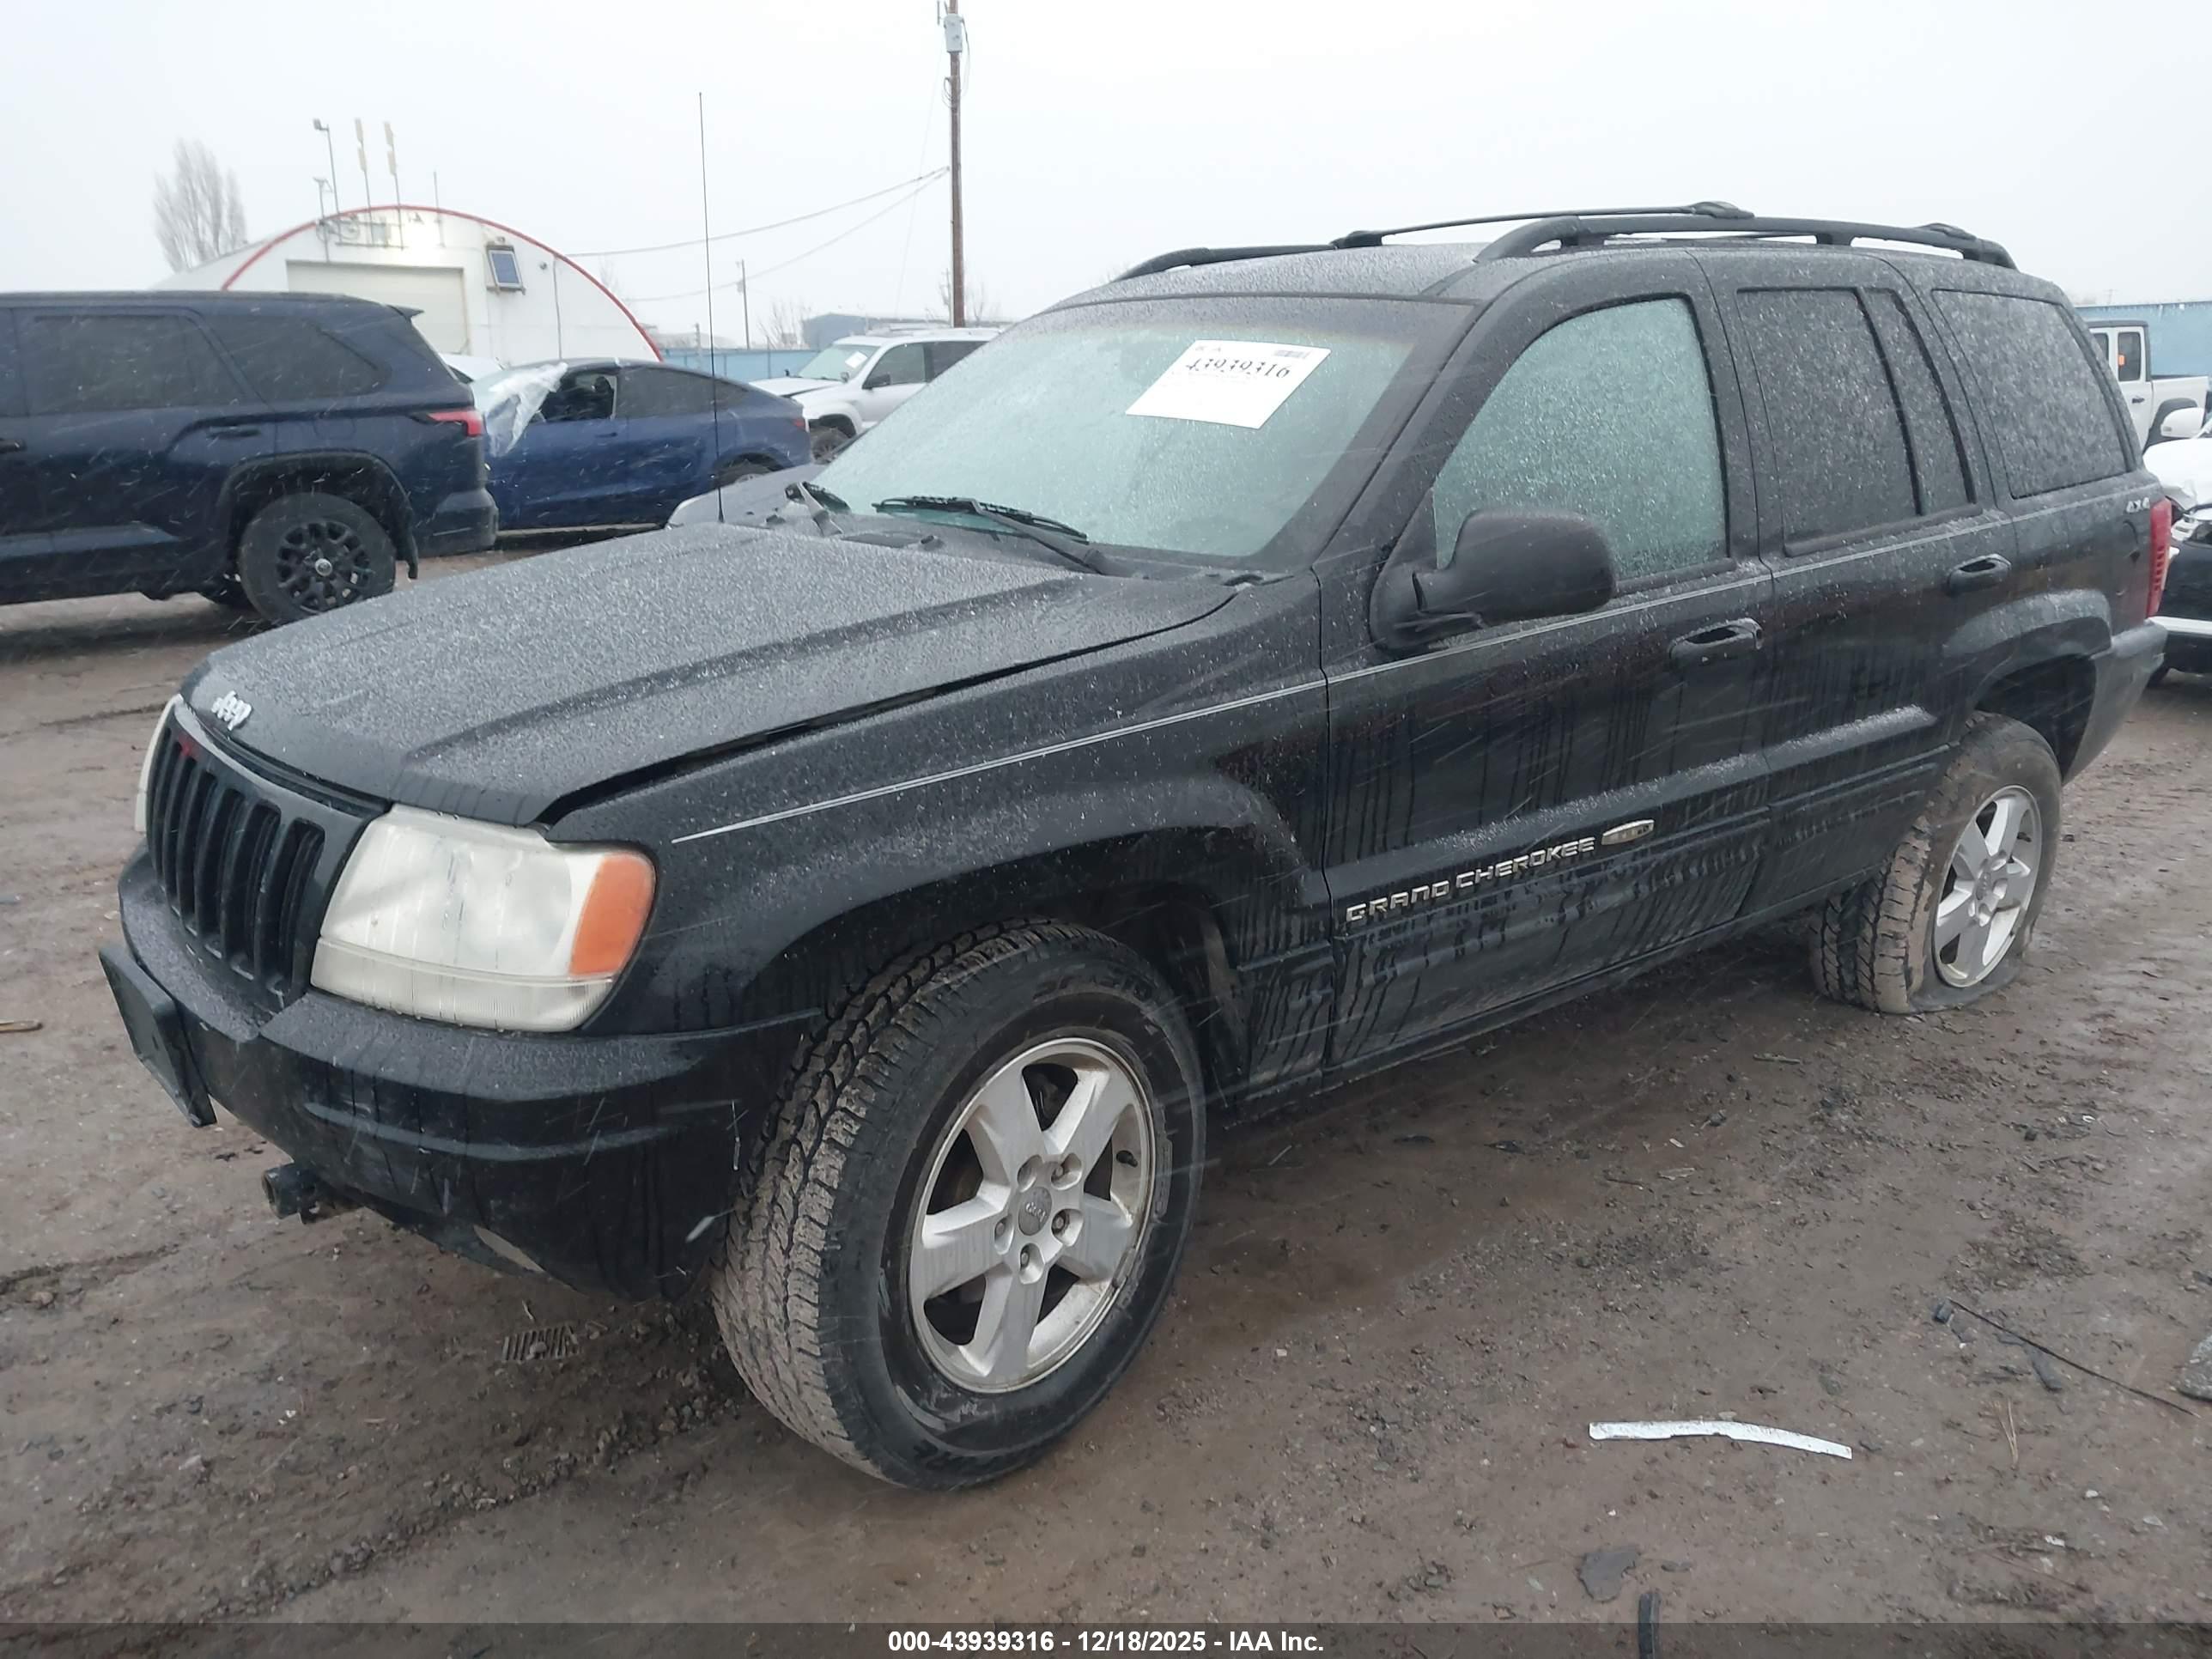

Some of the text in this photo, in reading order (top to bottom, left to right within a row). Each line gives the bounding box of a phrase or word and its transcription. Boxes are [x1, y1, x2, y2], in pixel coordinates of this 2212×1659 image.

[1186, 358, 1291, 378] 43939316
[1346, 836, 1596, 922] GRAND CHEROKEE
